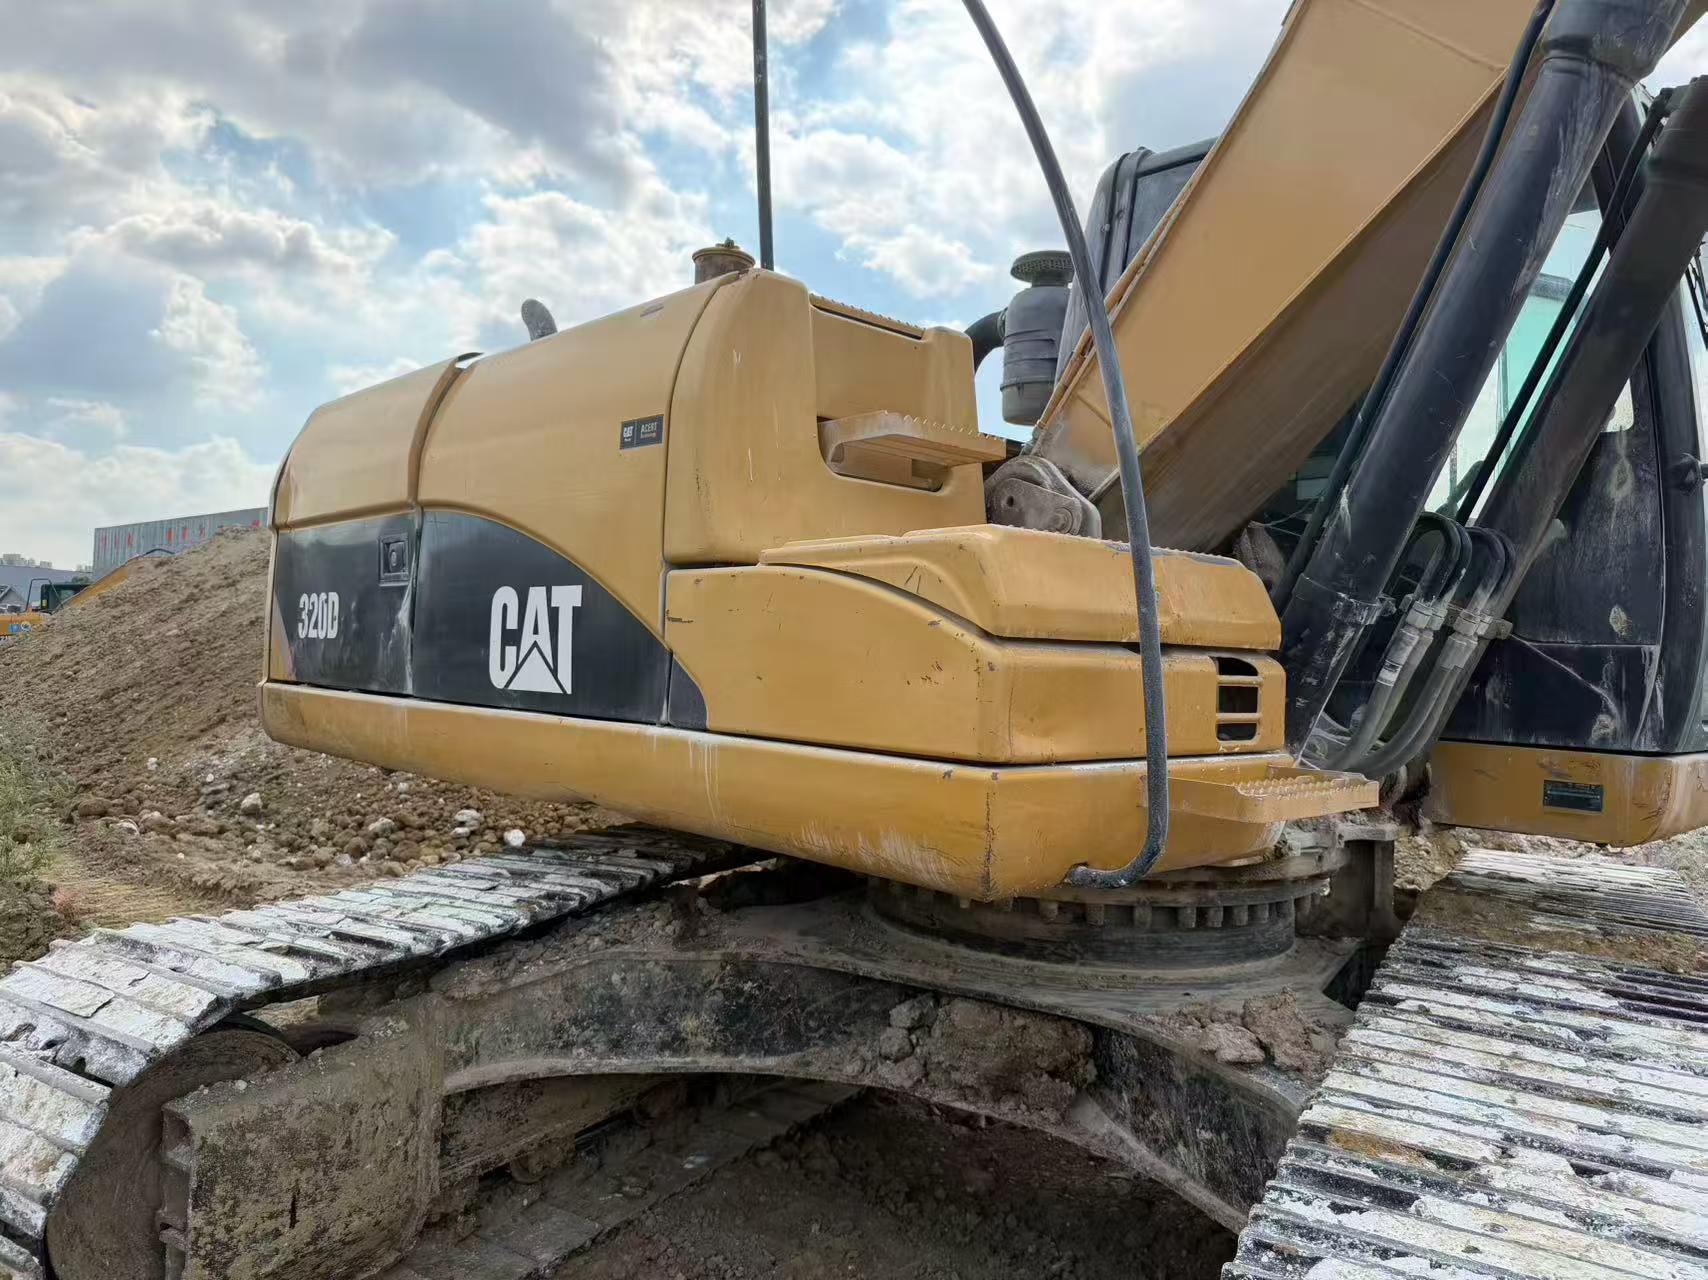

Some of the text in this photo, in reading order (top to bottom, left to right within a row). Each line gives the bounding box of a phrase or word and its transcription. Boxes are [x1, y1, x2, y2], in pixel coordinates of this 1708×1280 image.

[623, 426, 634, 437] CAT
[298, 592, 339, 639] 320D
[489, 585, 582, 694] CAT
